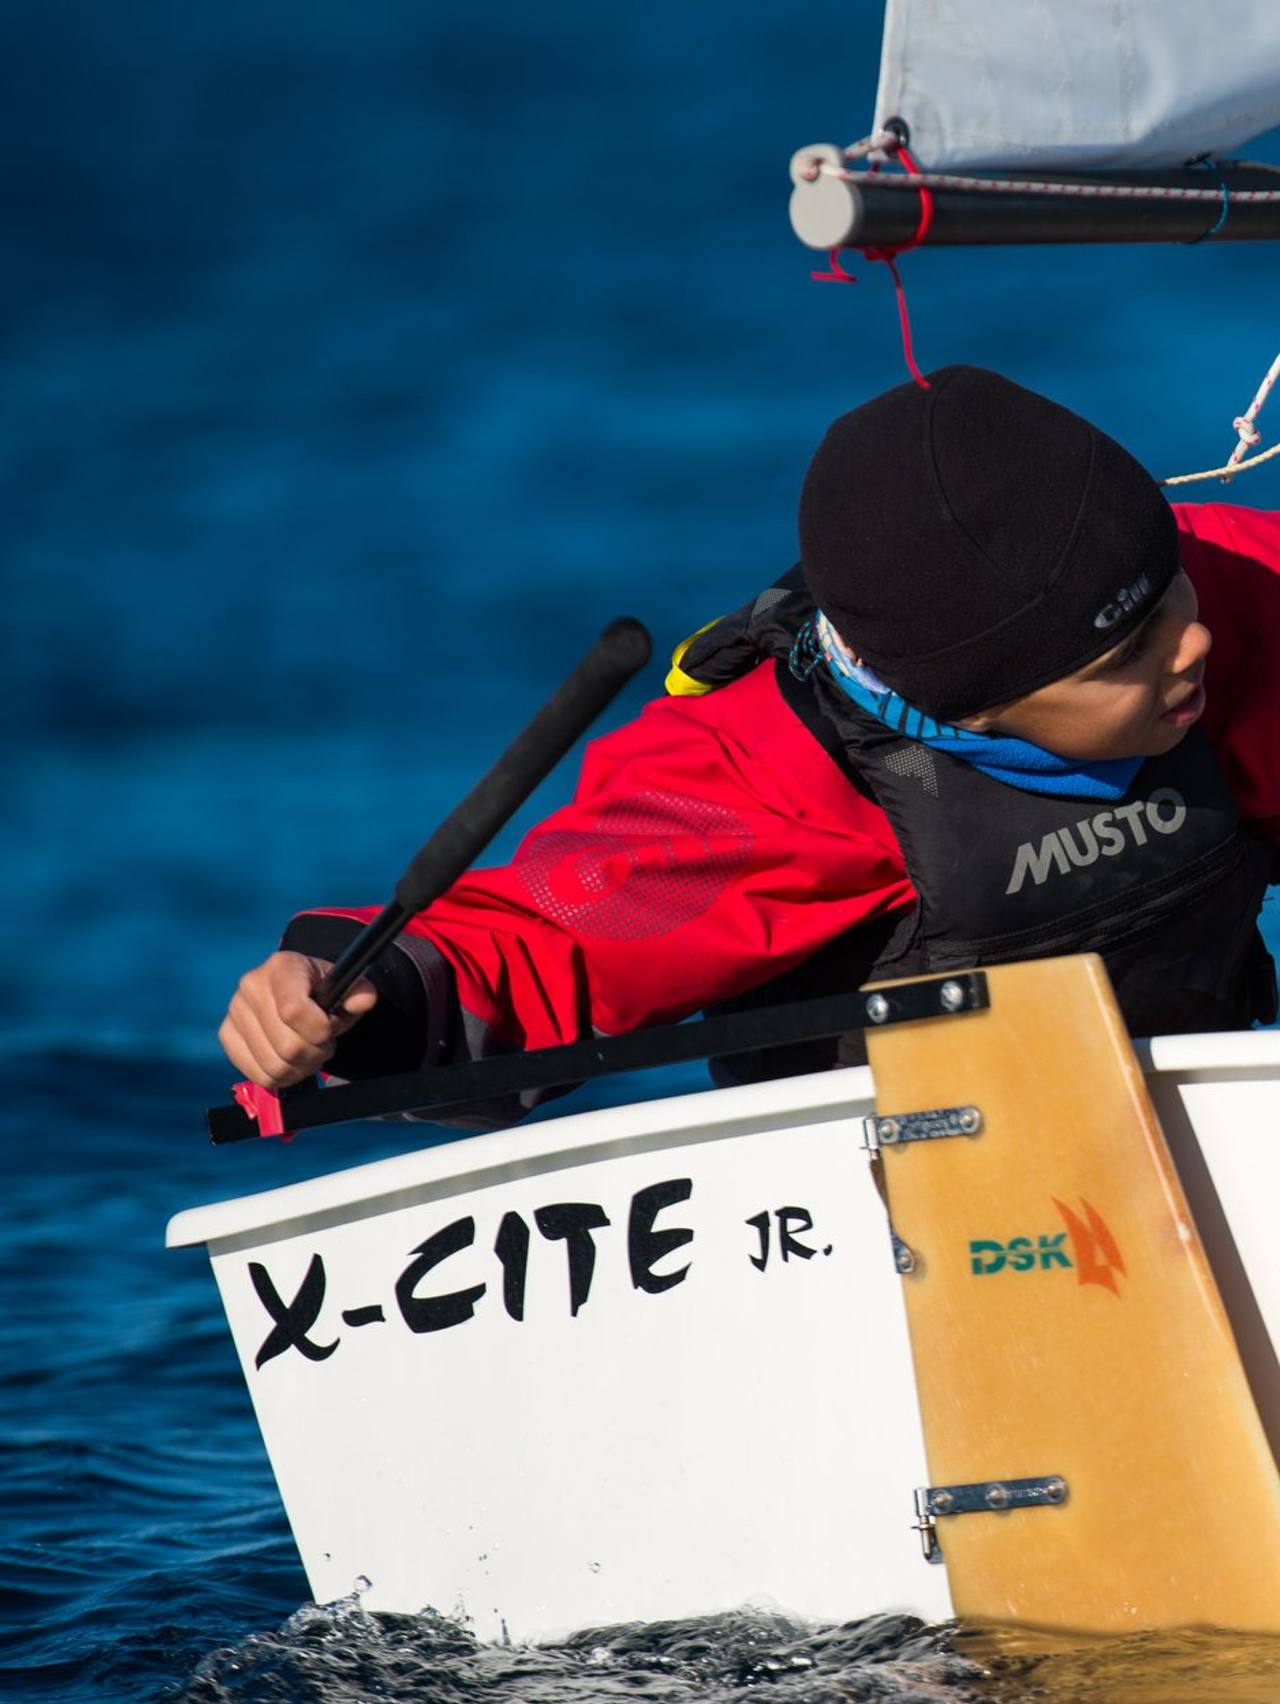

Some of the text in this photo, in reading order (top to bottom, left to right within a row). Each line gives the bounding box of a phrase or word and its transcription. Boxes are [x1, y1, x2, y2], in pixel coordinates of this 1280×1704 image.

[1005, 787, 1187, 895] MUSTO
[247, 1178, 833, 1371] X-CITE JR.
[970, 1232, 1073, 1275] DSK
